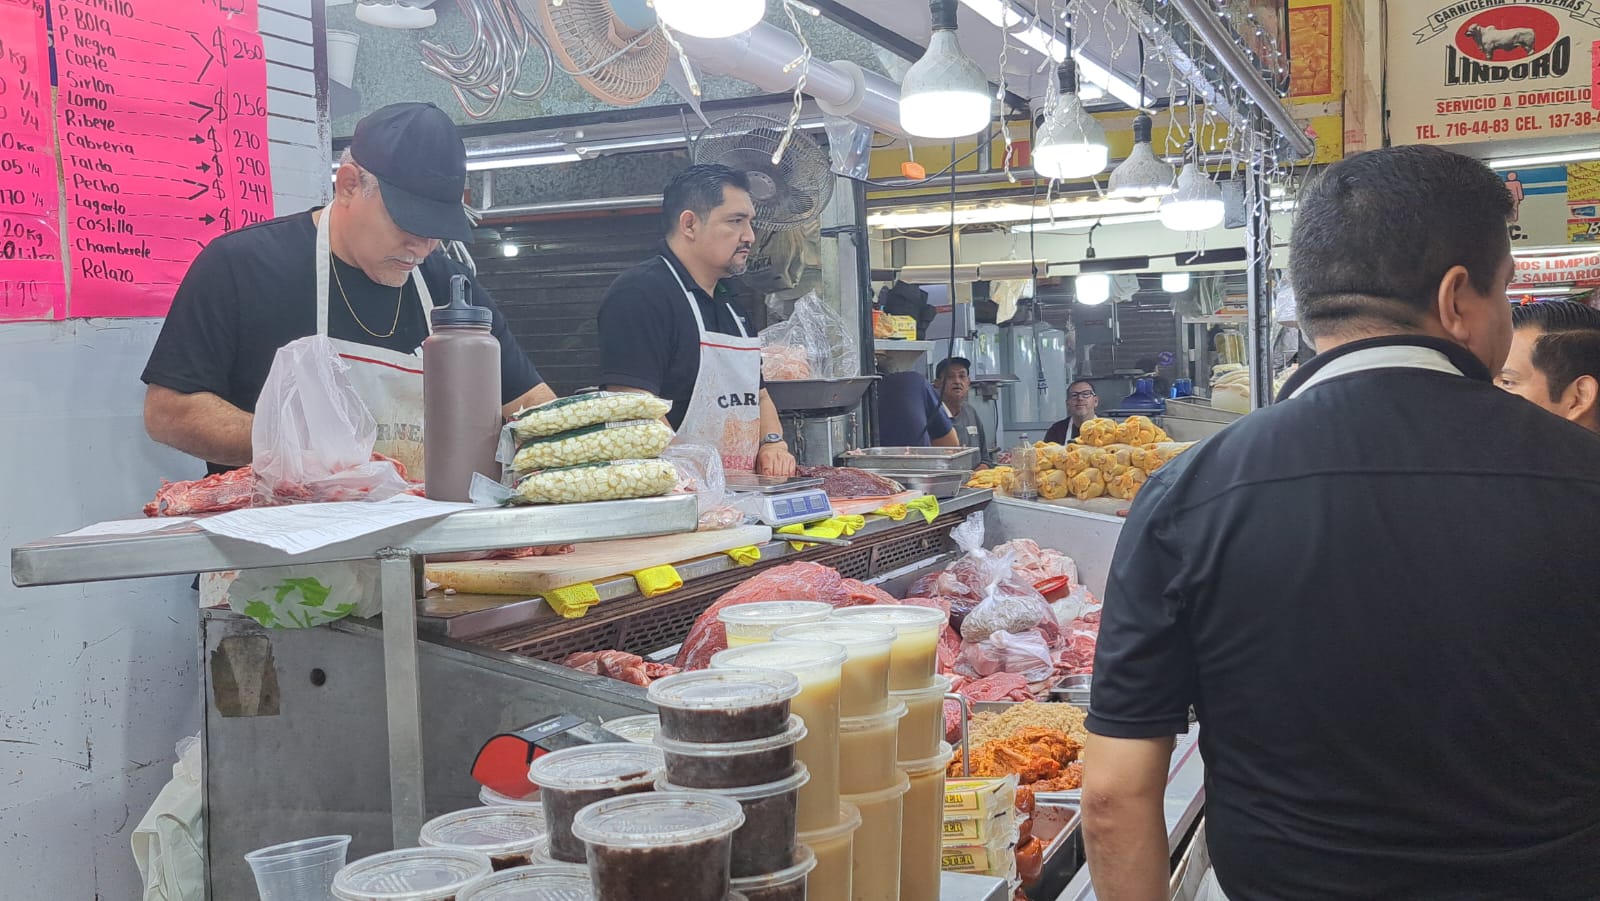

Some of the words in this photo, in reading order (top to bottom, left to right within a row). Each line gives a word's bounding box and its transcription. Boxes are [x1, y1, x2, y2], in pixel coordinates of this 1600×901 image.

[73, 33, 117, 60] Negra
[232, 38, 263, 60] 250
[1444, 35, 1571, 86] LINDORO
[232, 92, 266, 117] 256
[1436, 96, 1497, 114] SERVICIO
[1503, 95, 1512, 107] A
[1518, 87, 1592, 107] DOMICILIO
[233, 128, 261, 150] 270
[1415, 125, 1440, 140] TEL.
[1446, 118, 1509, 138] 716-44-83
[1515, 115, 1542, 132] CEL.
[235, 156, 266, 176] 290
[239, 180, 269, 205] 244
[717, 392, 760, 409] CAR
[376, 422, 424, 444] RNE
